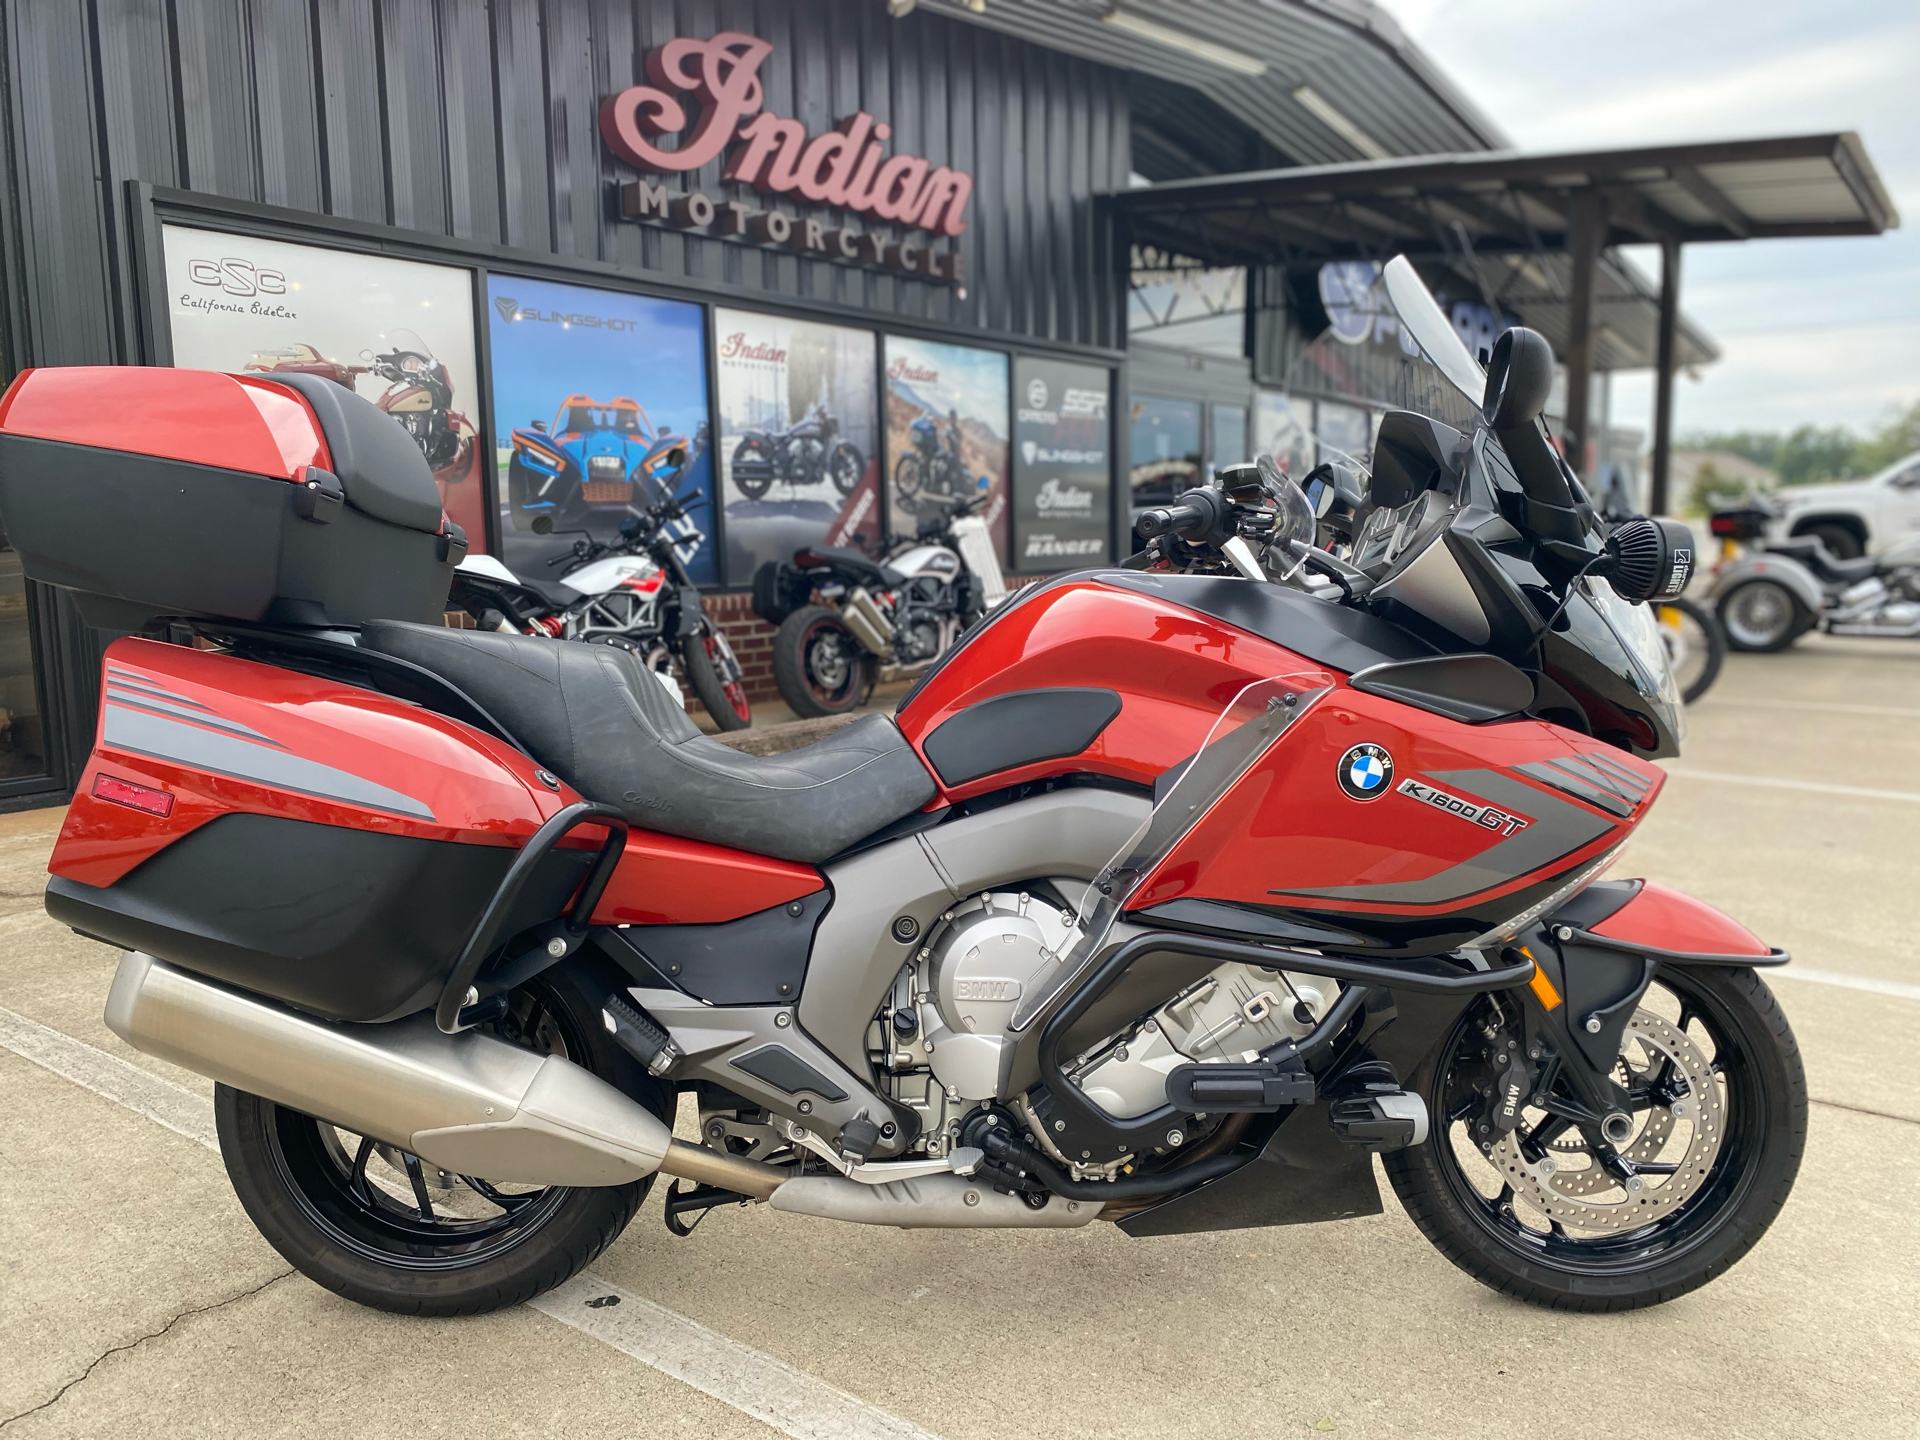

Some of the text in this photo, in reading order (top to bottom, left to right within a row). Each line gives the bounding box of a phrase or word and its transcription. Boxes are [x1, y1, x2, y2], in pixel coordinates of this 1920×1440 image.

[600, 31, 973, 236] Indian
[637, 180, 967, 280] MOTORCYCLE
[180, 294, 297, 319] California SideCar
[521, 308, 638, 332] SLINGSHOT
[720, 332, 787, 364] Indian
[887, 356, 939, 383] Indian
[1035, 478, 1093, 510] Indian
[1025, 539, 1104, 557] RANGER
[1665, 565, 1684, 593] LIGHTS
[1350, 746, 1392, 769] BMW
[957, 981, 1009, 999] BMW
[1503, 1084, 1520, 1117] BMW
